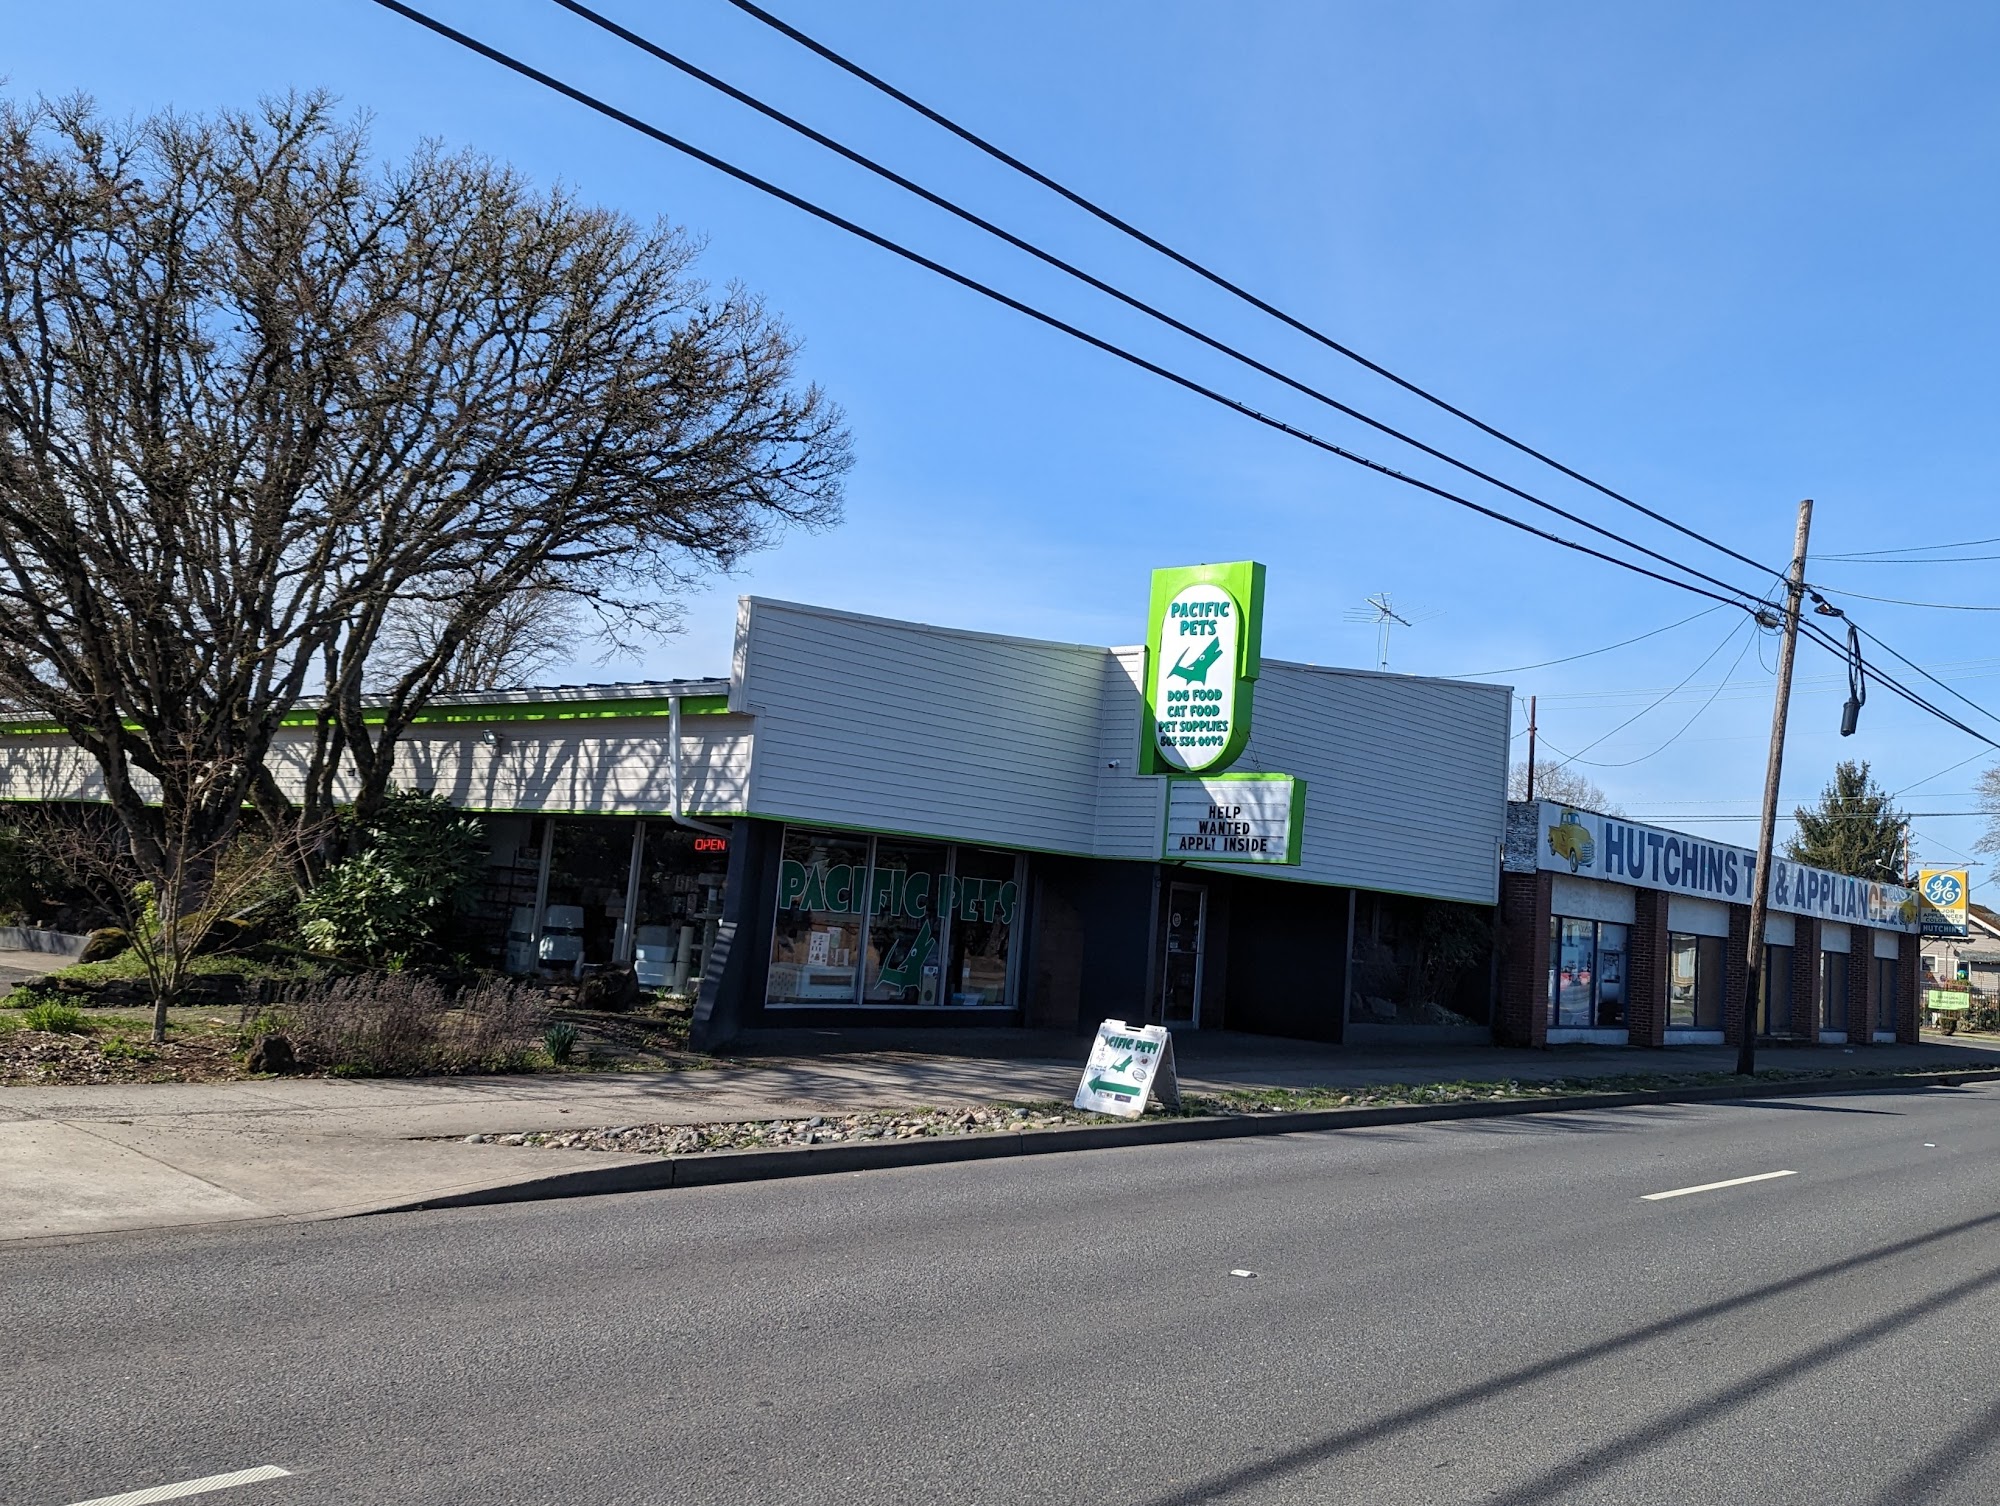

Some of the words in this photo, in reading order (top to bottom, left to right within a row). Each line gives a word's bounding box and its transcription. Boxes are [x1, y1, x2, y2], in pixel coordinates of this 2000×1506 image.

[1171, 601, 1230, 618] PACIFIC
[1180, 619, 1217, 636] PETS
[1167, 689, 1190, 702] DOG
[1192, 689, 1223, 702] FOOD
[1167, 705, 1188, 718] CAT
[1190, 704, 1220, 717] FOOD
[1158, 720, 1178, 733] PET
[1179, 720, 1228, 733] SUPPLIES
[1208, 805, 1241, 819] HELP
[1199, 820, 1250, 835] WANTED
[694, 838, 726, 851] OPEN
[1180, 836, 1216, 851] APPLY
[1224, 838, 1267, 852] INSIDE
[1605, 823, 1738, 896] HUTCHINS
[1743, 854, 1757, 898] T
[1775, 863, 1789, 906] &
[779, 859, 930, 919] PACIFIC
[938, 873, 1018, 925] PETS
[1134, 1039, 1160, 1055] PETS
